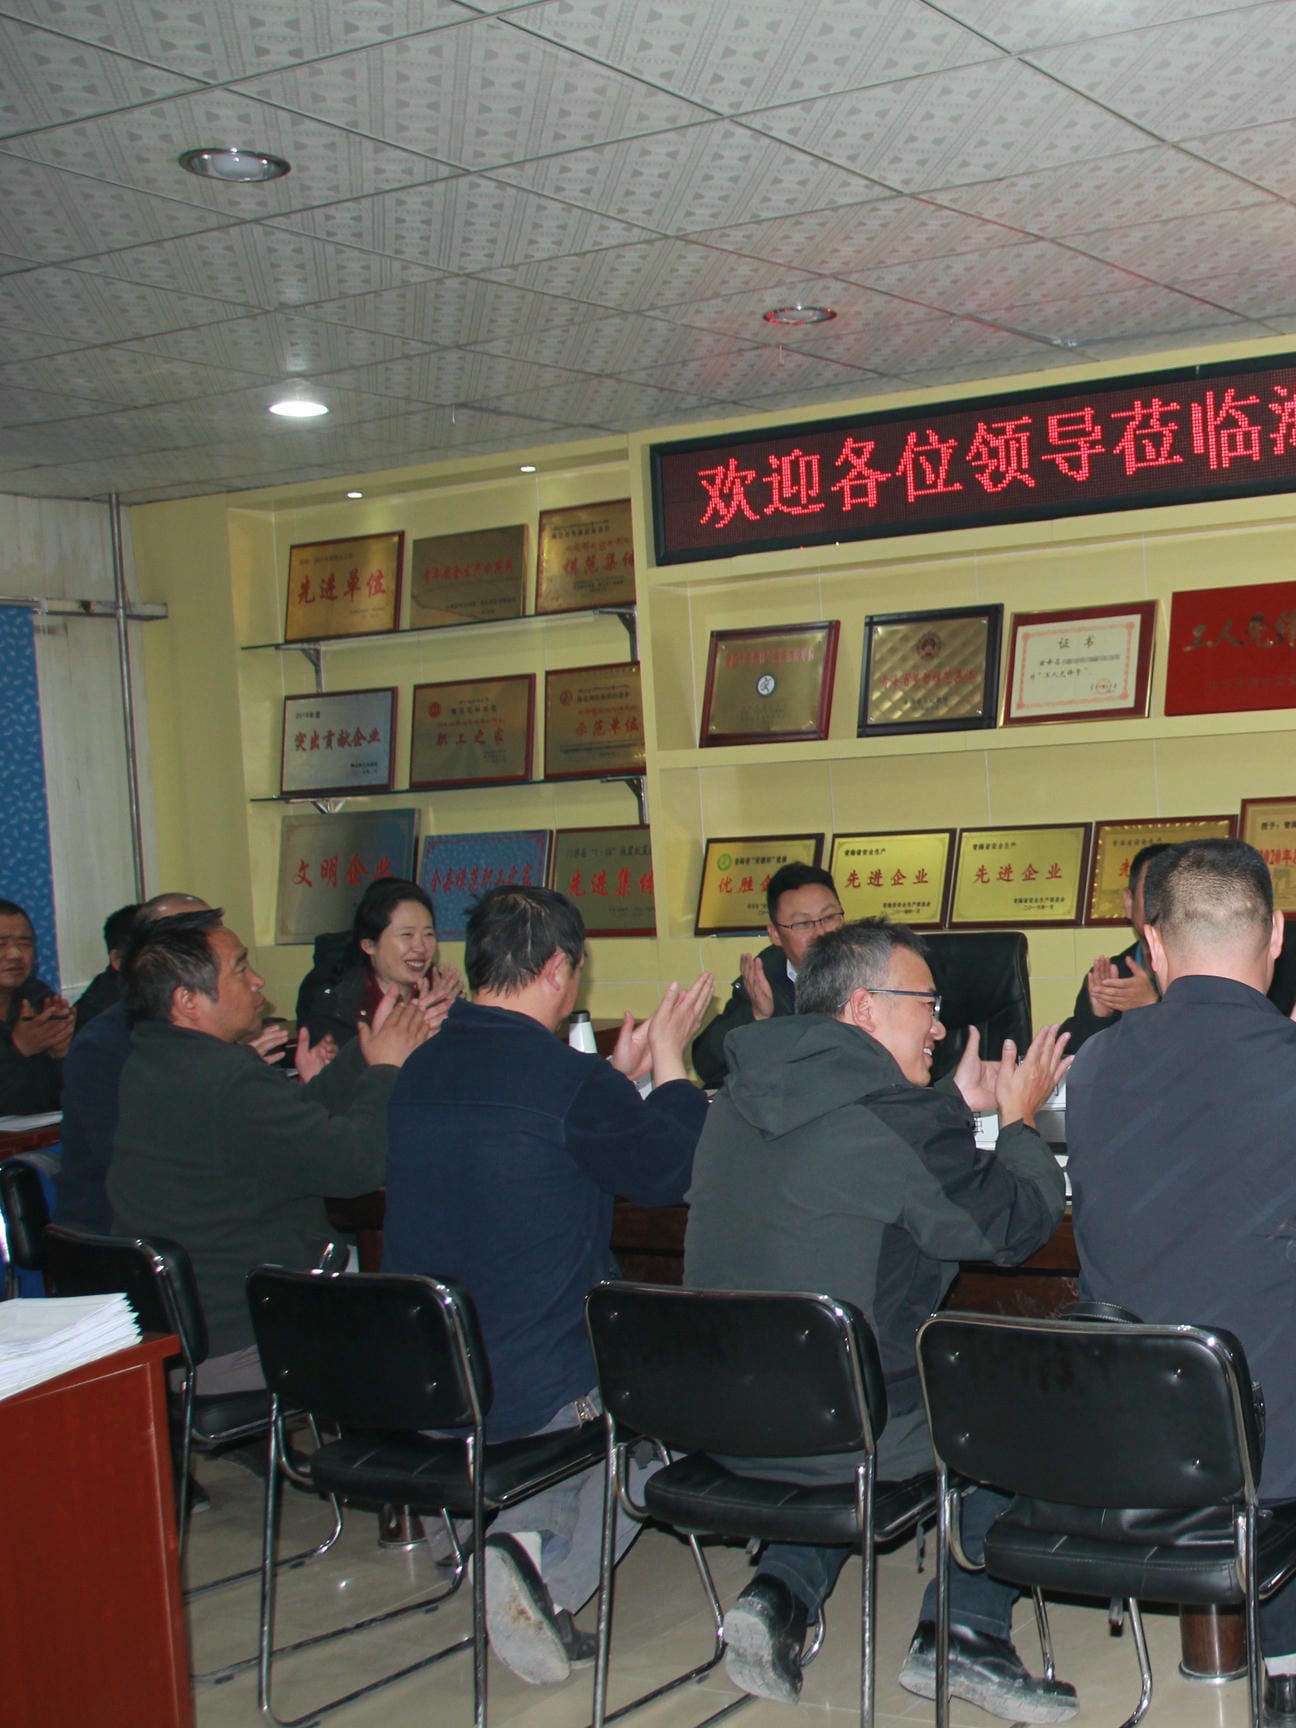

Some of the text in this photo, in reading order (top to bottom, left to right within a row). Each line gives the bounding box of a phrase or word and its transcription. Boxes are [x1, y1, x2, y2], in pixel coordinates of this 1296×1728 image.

[298, 567, 386, 605] 先进单位
[294, 726, 381, 752] 突出贡献企业
[292, 851, 395, 889] 文明企业
[844, 867, 929, 889] 先进企业
[972, 862, 1063, 884] 先进企业
